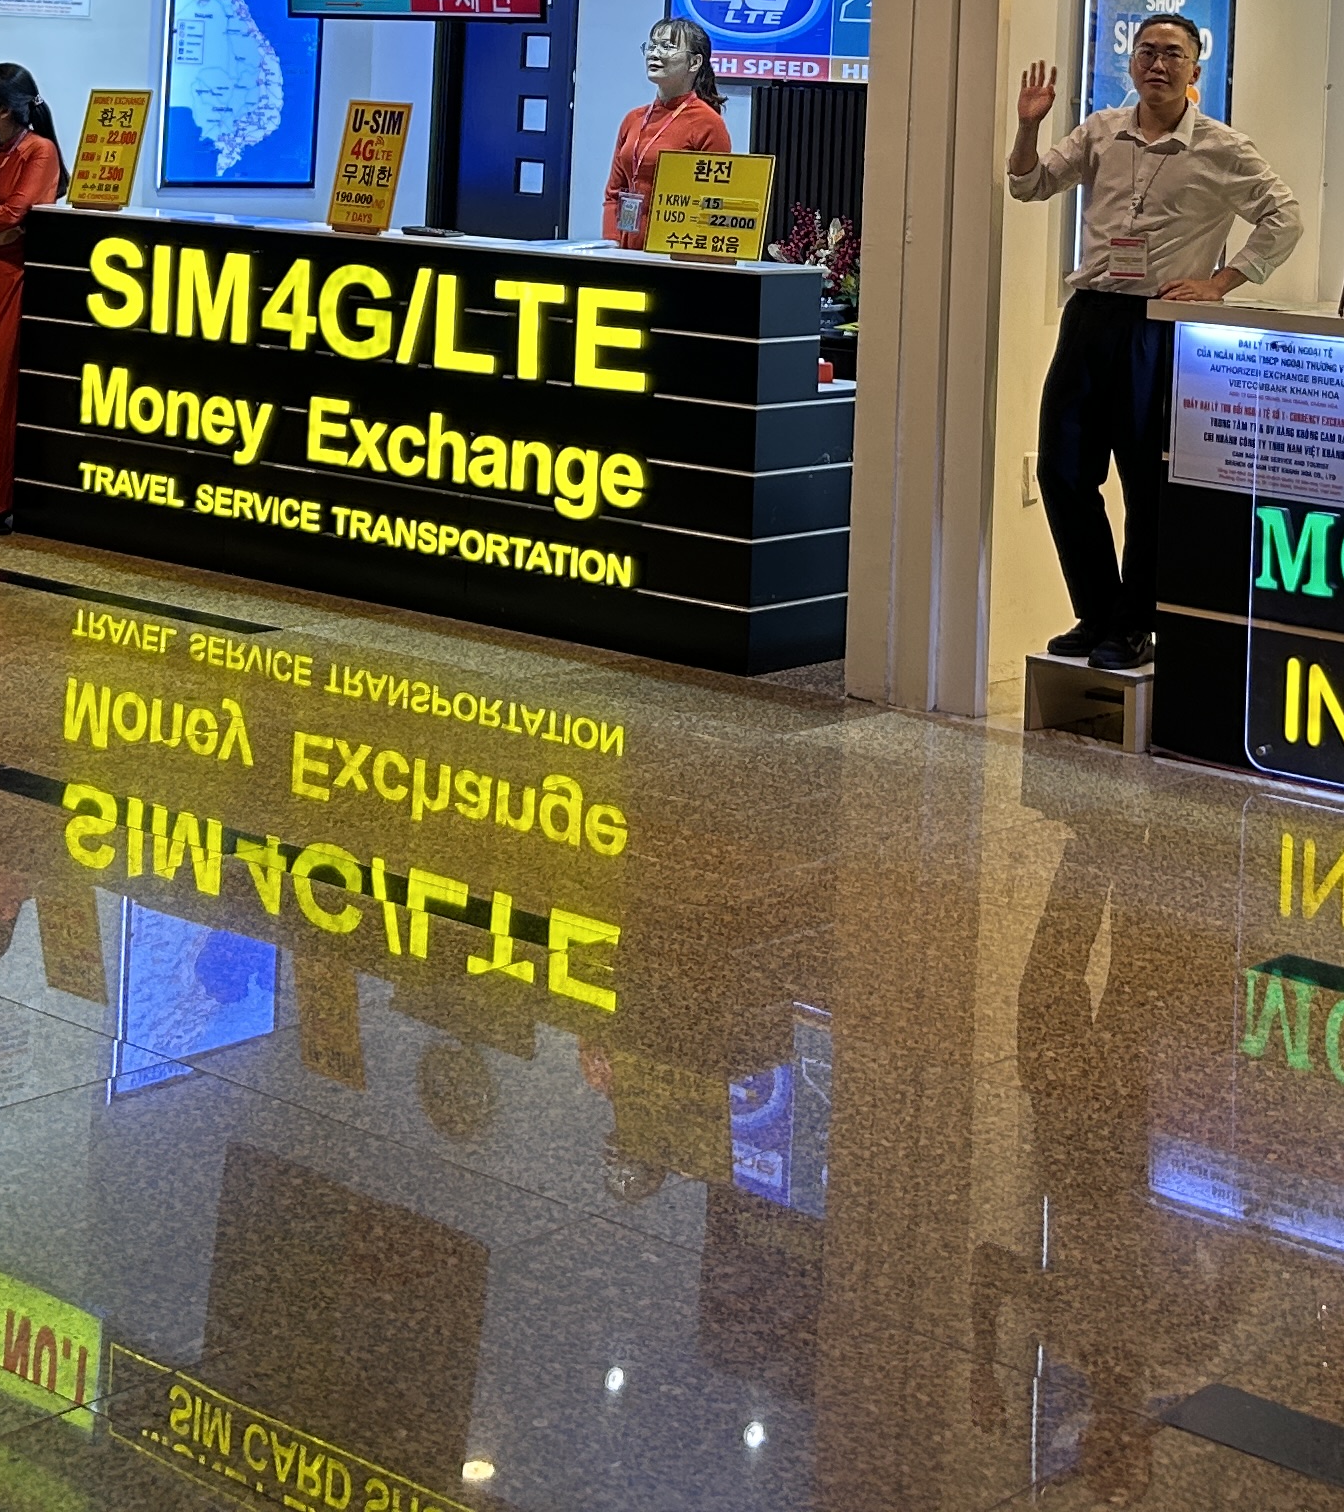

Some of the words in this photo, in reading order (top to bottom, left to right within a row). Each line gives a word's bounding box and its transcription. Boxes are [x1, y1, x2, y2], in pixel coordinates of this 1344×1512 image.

[724, 10, 784, 26] LTE
[743, 60, 820, 78] SPEED
[97, 107, 134, 128] 환전
[352, 108, 404, 136] U-SIM
[351, 138, 375, 162] 4G
[342, 163, 392, 187] 무제한
[693, 159, 733, 184] 환전
[336, 191, 373, 205] 190.000
[666, 194, 691, 207] KRW
[705, 198, 720, 209] 15
[351, 211, 373, 224] DAYS
[664, 211, 685, 223] USD
[709, 215, 755, 229] 22.000
[666, 231, 707, 249] 수수료
[711, 234, 740, 253] 없음
[87, 237, 251, 345] SIM
[261, 258, 647, 393] 4G/LTE
[79, 363, 274, 465] Money
[307, 395, 645, 520] Exchange
[79, 462, 184, 509] TRAVEL
[194, 483, 321, 532] SERVICE
[331, 505, 633, 588] TRANSPORTATION
